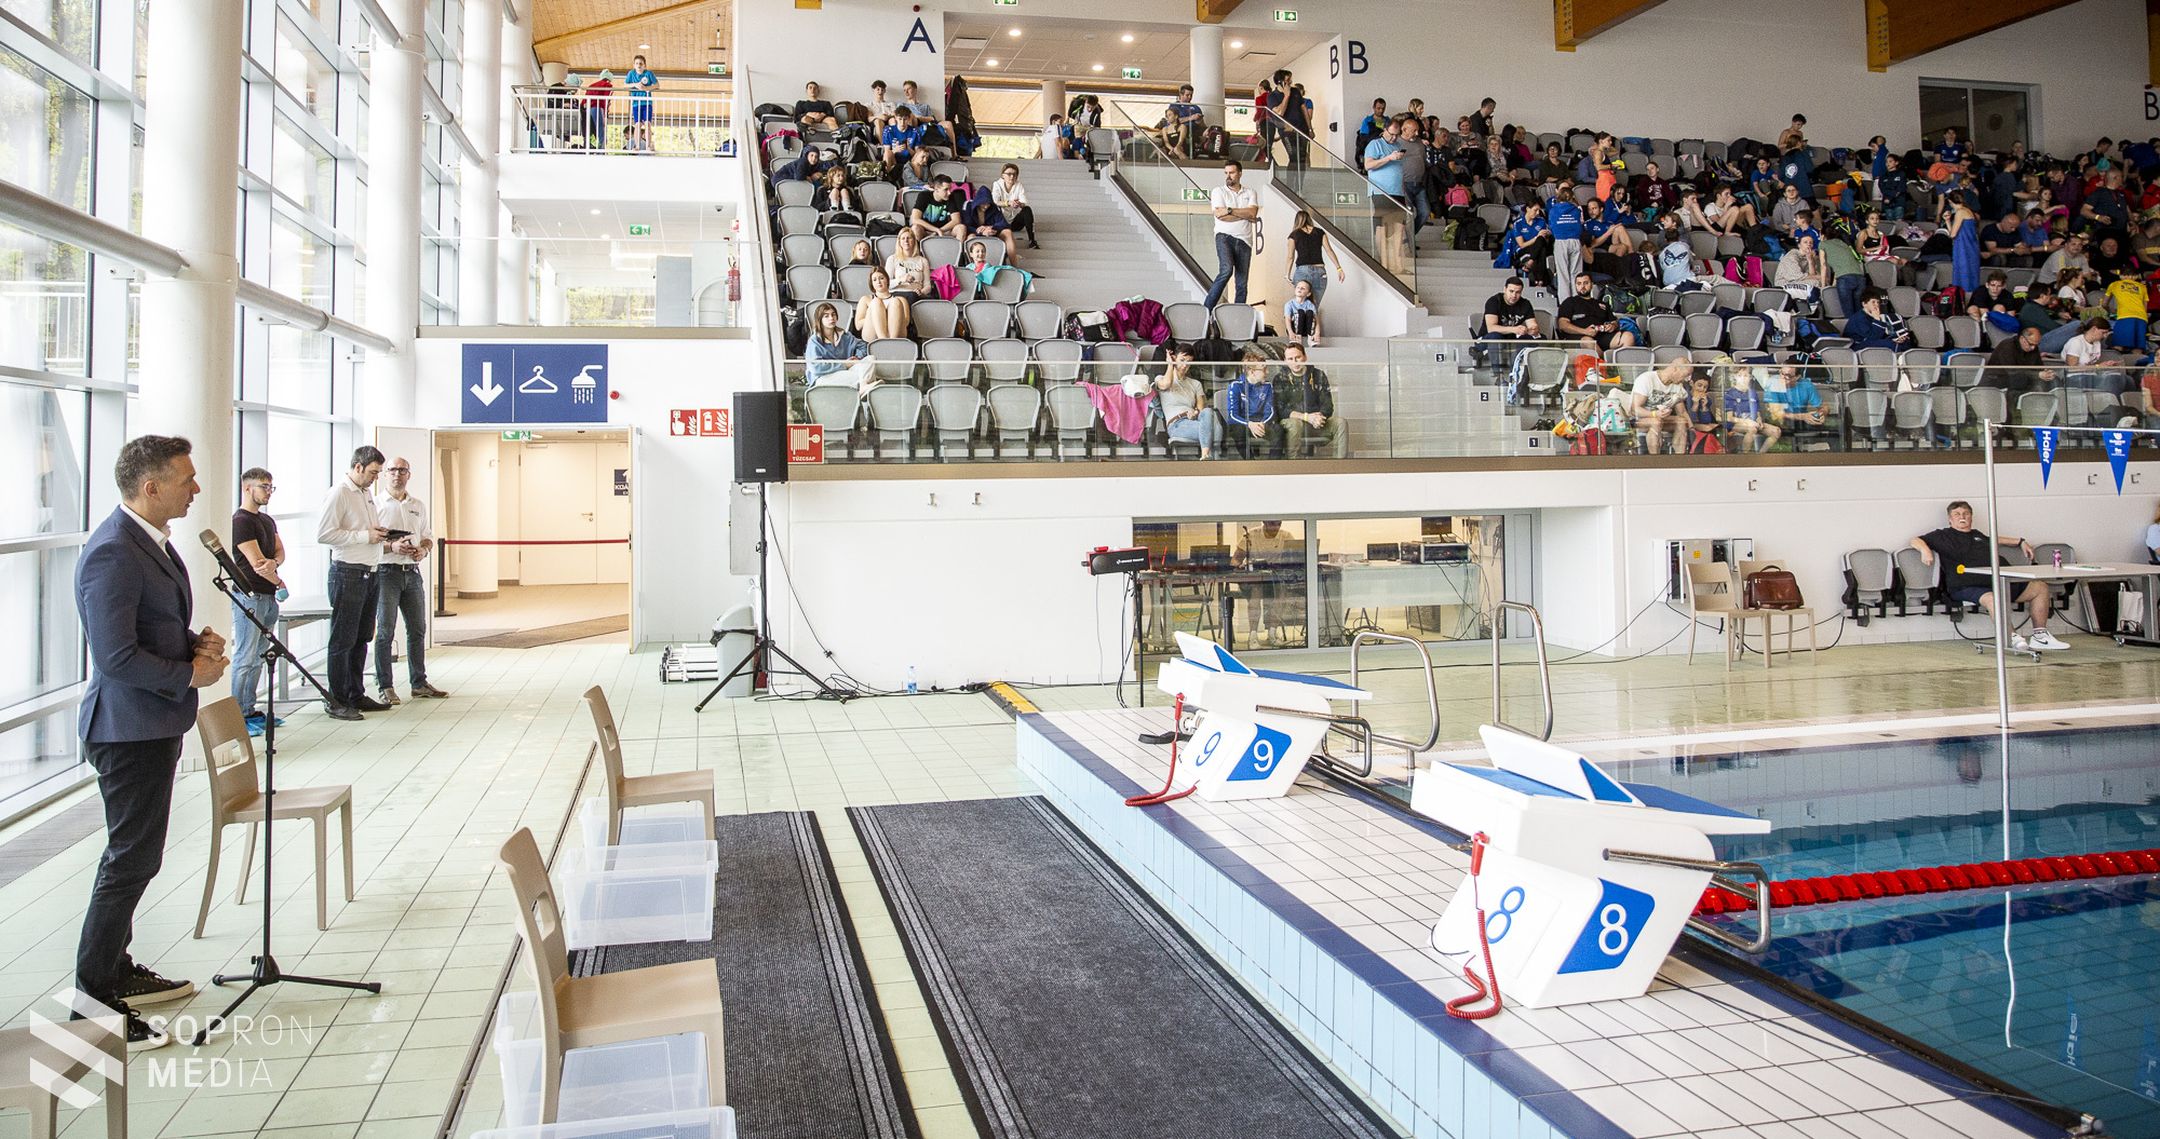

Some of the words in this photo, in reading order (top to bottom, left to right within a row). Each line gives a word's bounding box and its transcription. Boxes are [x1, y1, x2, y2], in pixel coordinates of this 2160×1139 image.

[901, 17, 936, 53] A
[1330, 45, 1340, 79] B
[1348, 40, 1369, 74] B
[2144, 91, 2160, 120] B
[1255, 216, 1265, 255] B
[1196, 731, 1221, 767] 9
[1253, 739, 1274, 772] 9
[1486, 886, 1525, 944] 8
[1598, 903, 1629, 956] 8
